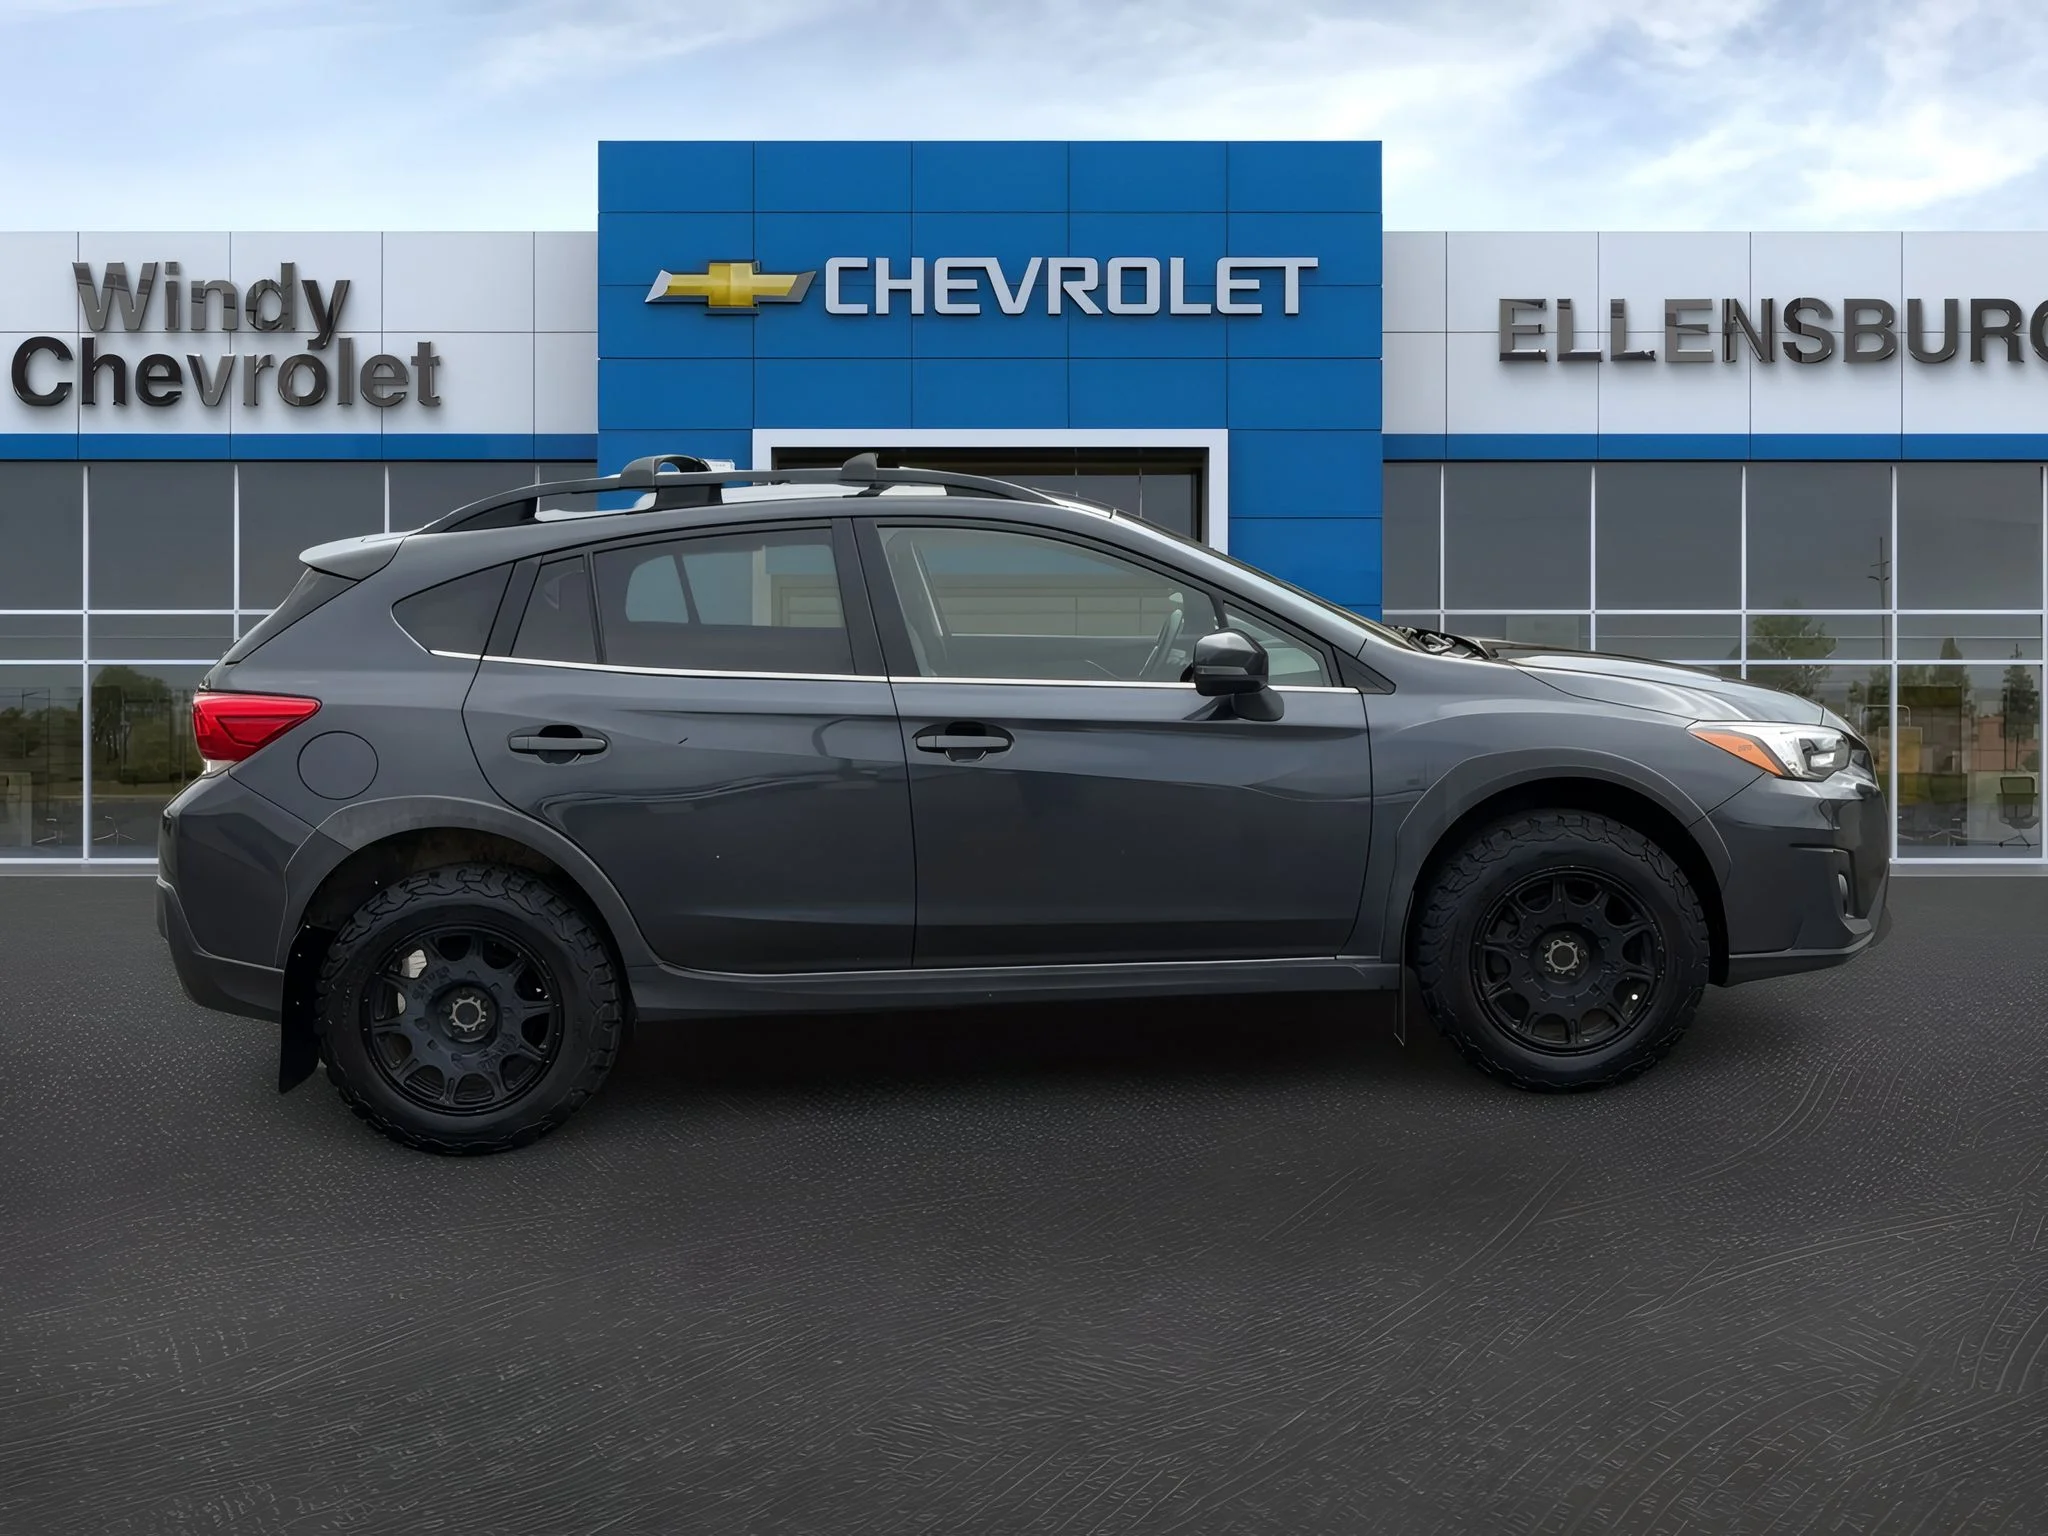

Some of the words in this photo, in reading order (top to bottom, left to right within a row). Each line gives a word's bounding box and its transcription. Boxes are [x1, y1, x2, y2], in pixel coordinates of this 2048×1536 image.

[72, 262, 350, 350] Windy
[824, 257, 1318, 315] CHEVROLET
[11, 336, 441, 407] Chevrolet
